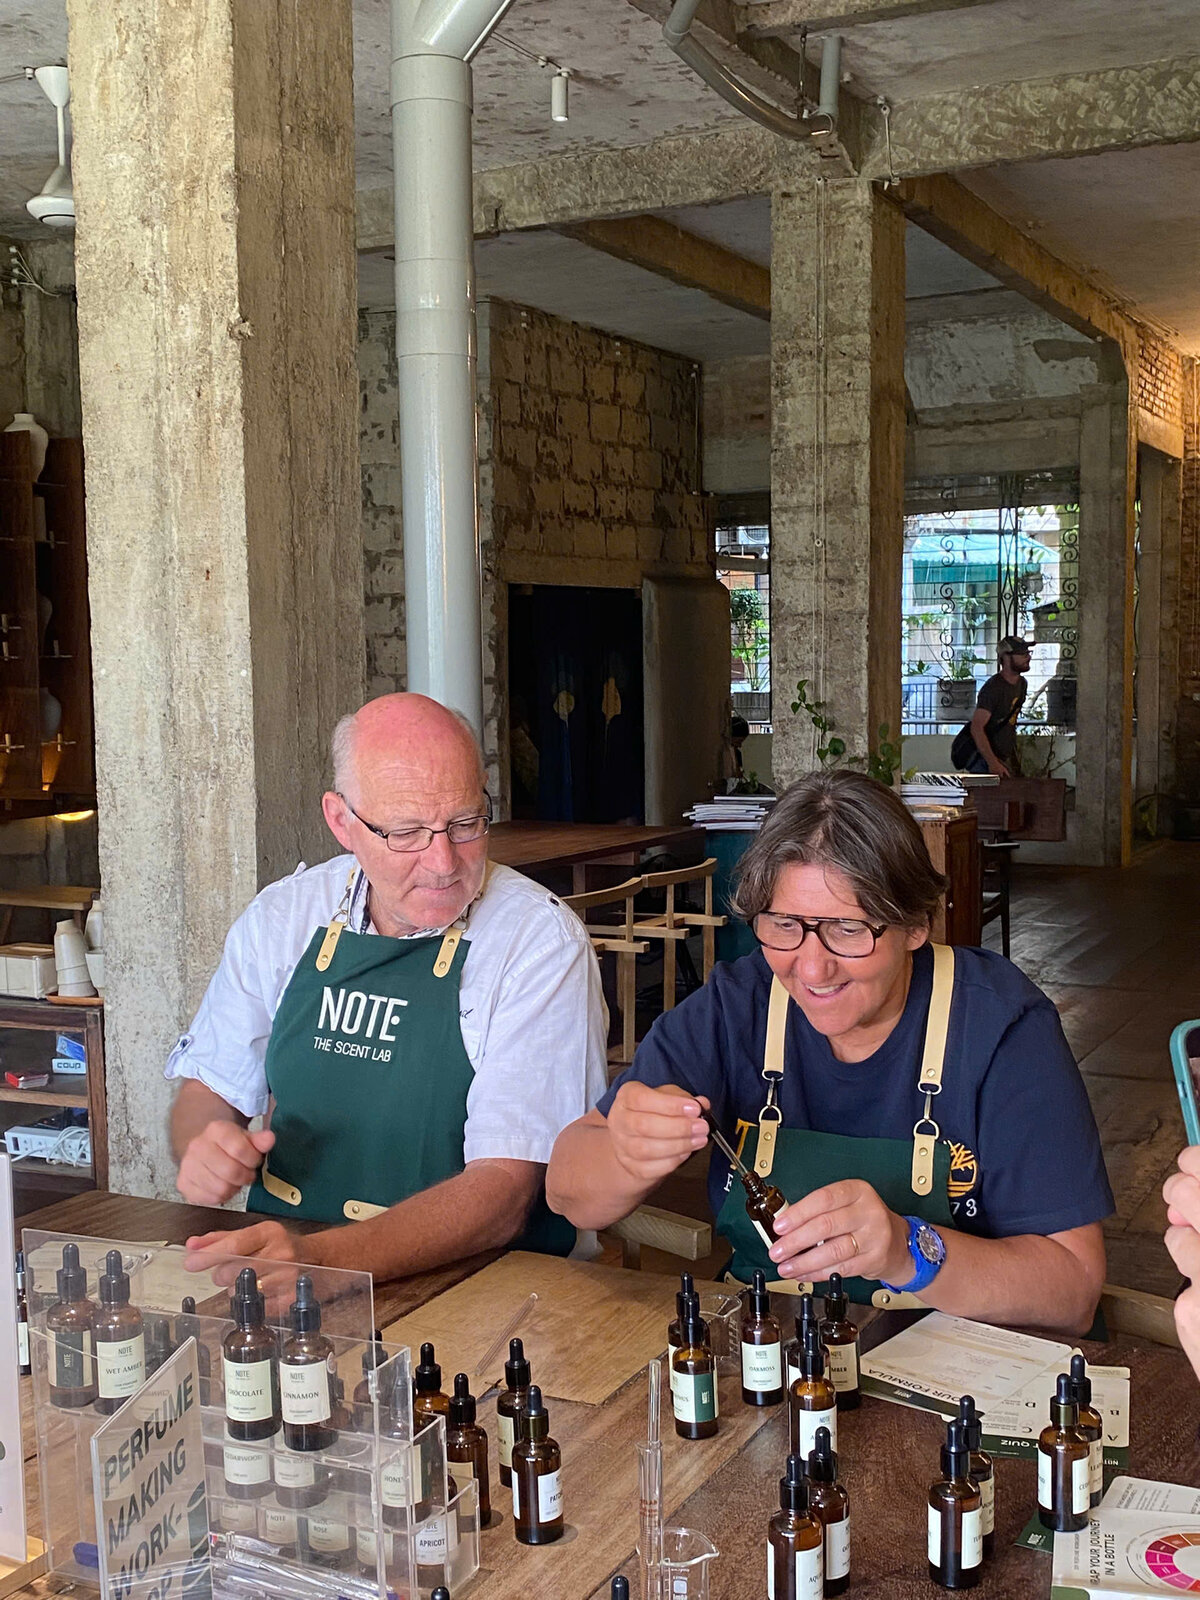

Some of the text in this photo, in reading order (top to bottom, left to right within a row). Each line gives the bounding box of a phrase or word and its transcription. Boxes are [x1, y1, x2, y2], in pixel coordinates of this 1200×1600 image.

[318, 986, 408, 1042] NOTE
[313, 1036, 392, 1063] THE SCENT LAB
[118, 1345, 133, 1355] NOTE
[105, 1366, 121, 1375] WET
[868, 1368, 961, 1402] OUR FORMULA
[227, 1388, 265, 1397] CHOCOLATE
[283, 1391, 320, 1400] CINNAMON
[104, 1373, 193, 1498] PERFUME
[1000, 1439, 1031, 1447] QUIZ
[1103, 1458, 1119, 1466] NOT
[108, 1438, 186, 1555] MAKING
[419, 1538, 445, 1548] APRICOT
[1104, 1533, 1116, 1560] BOTTLE
[1090, 1518, 1101, 1586] RAP YOUR JOURNEY
[1105, 1567, 1116, 1577] IN
